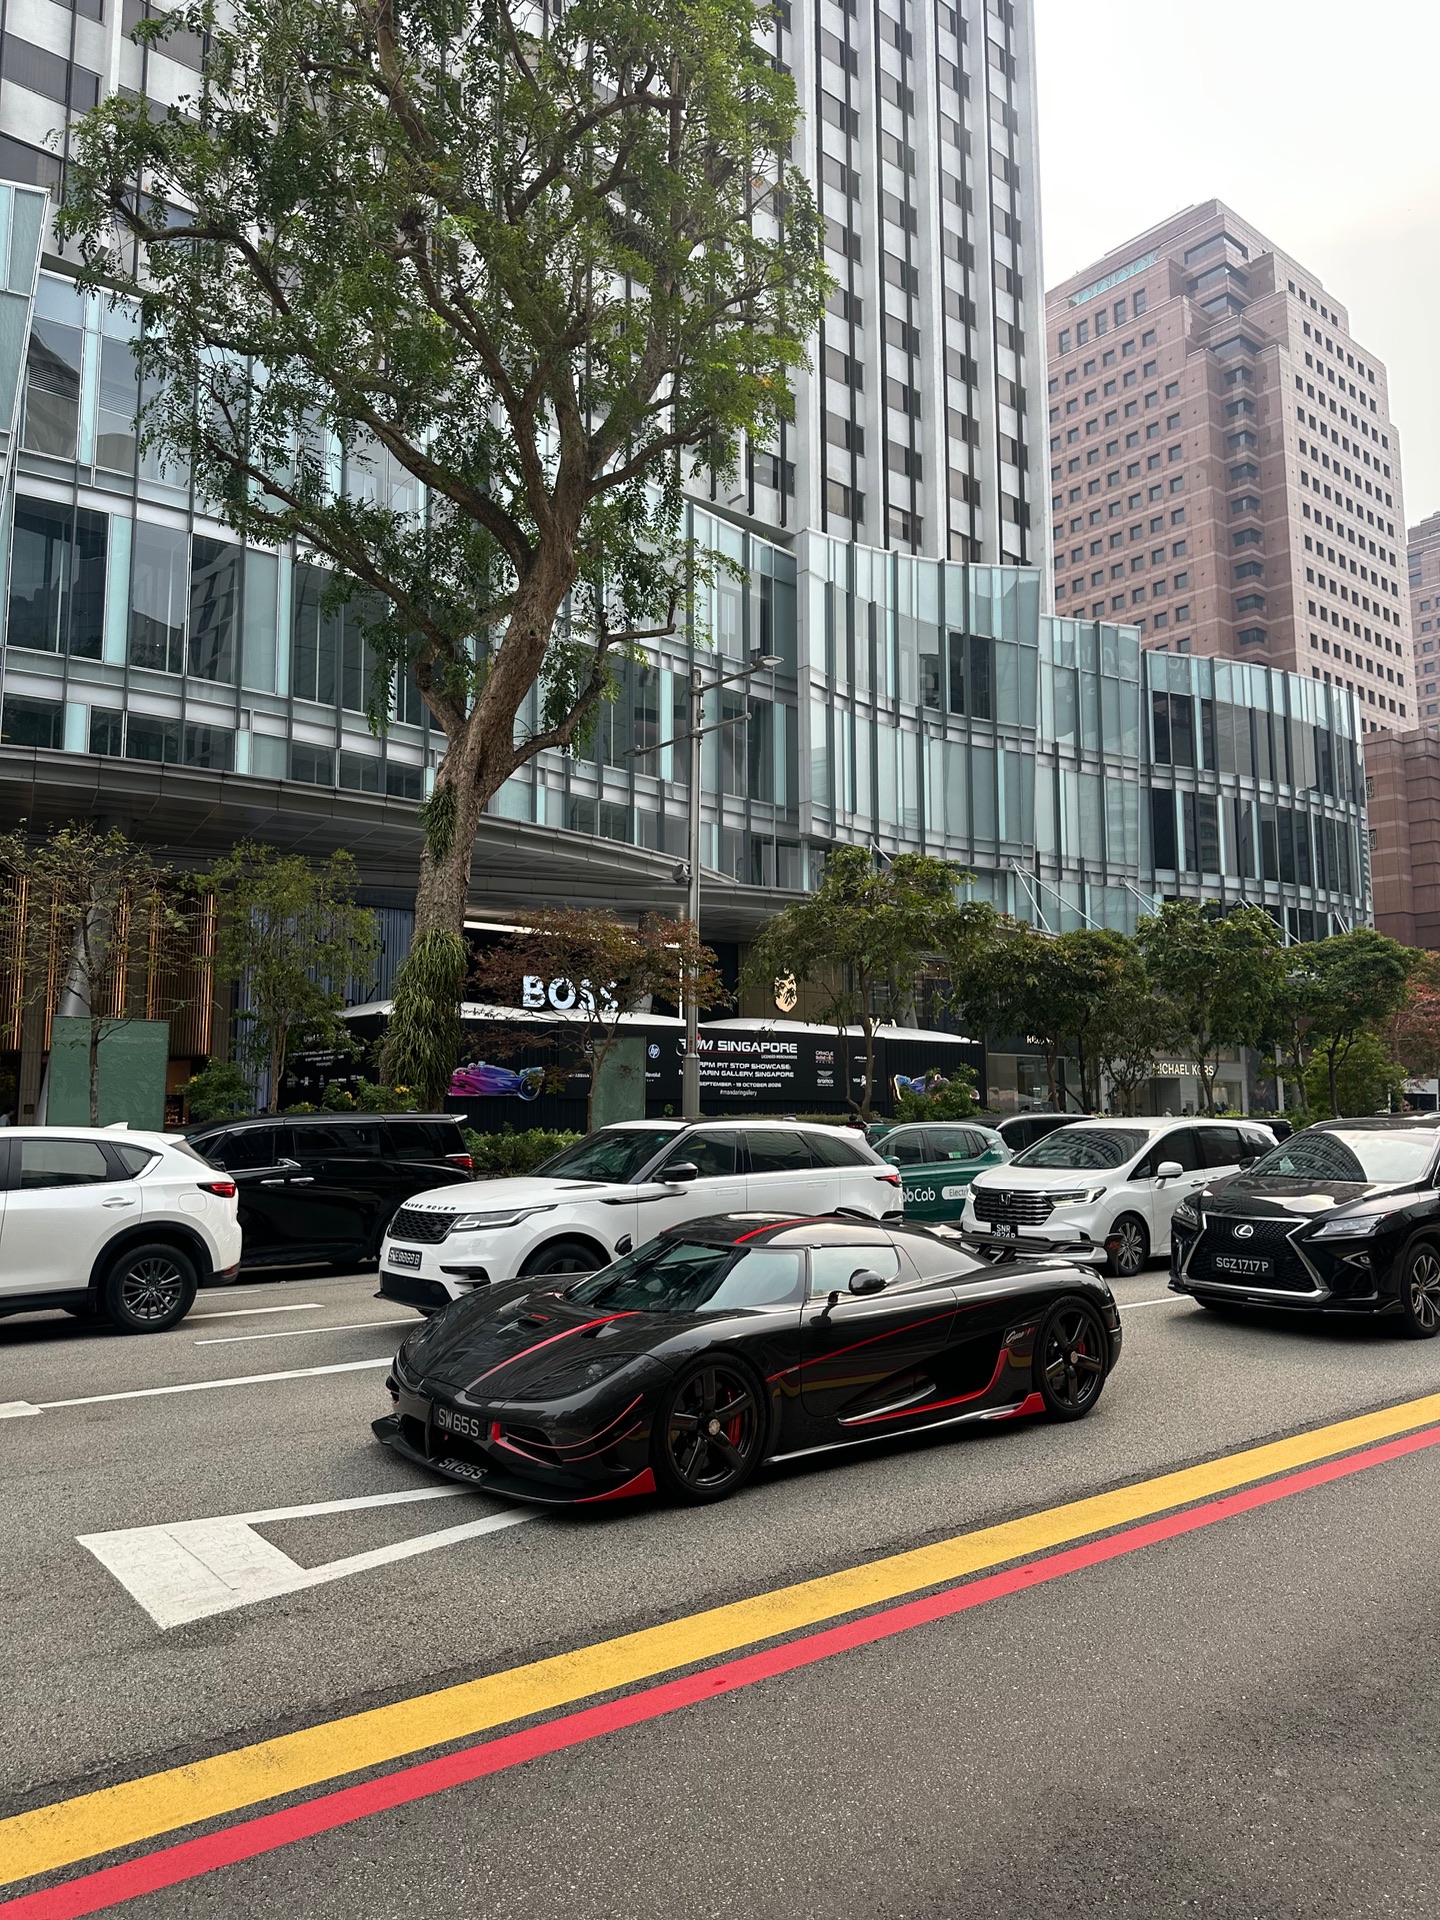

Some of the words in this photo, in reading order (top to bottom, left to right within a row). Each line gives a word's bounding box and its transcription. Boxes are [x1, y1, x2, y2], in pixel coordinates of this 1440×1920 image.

[717, 1040, 798, 1053] SINGAPORE
[902, 1187, 936, 1203] abCab
[949, 1188, 968, 1198] Electri
[1216, 1256, 1269, 1272] SGZ1717P
[438, 1408, 480, 1437] SW65S
[438, 1458, 489, 1479] SW65S
